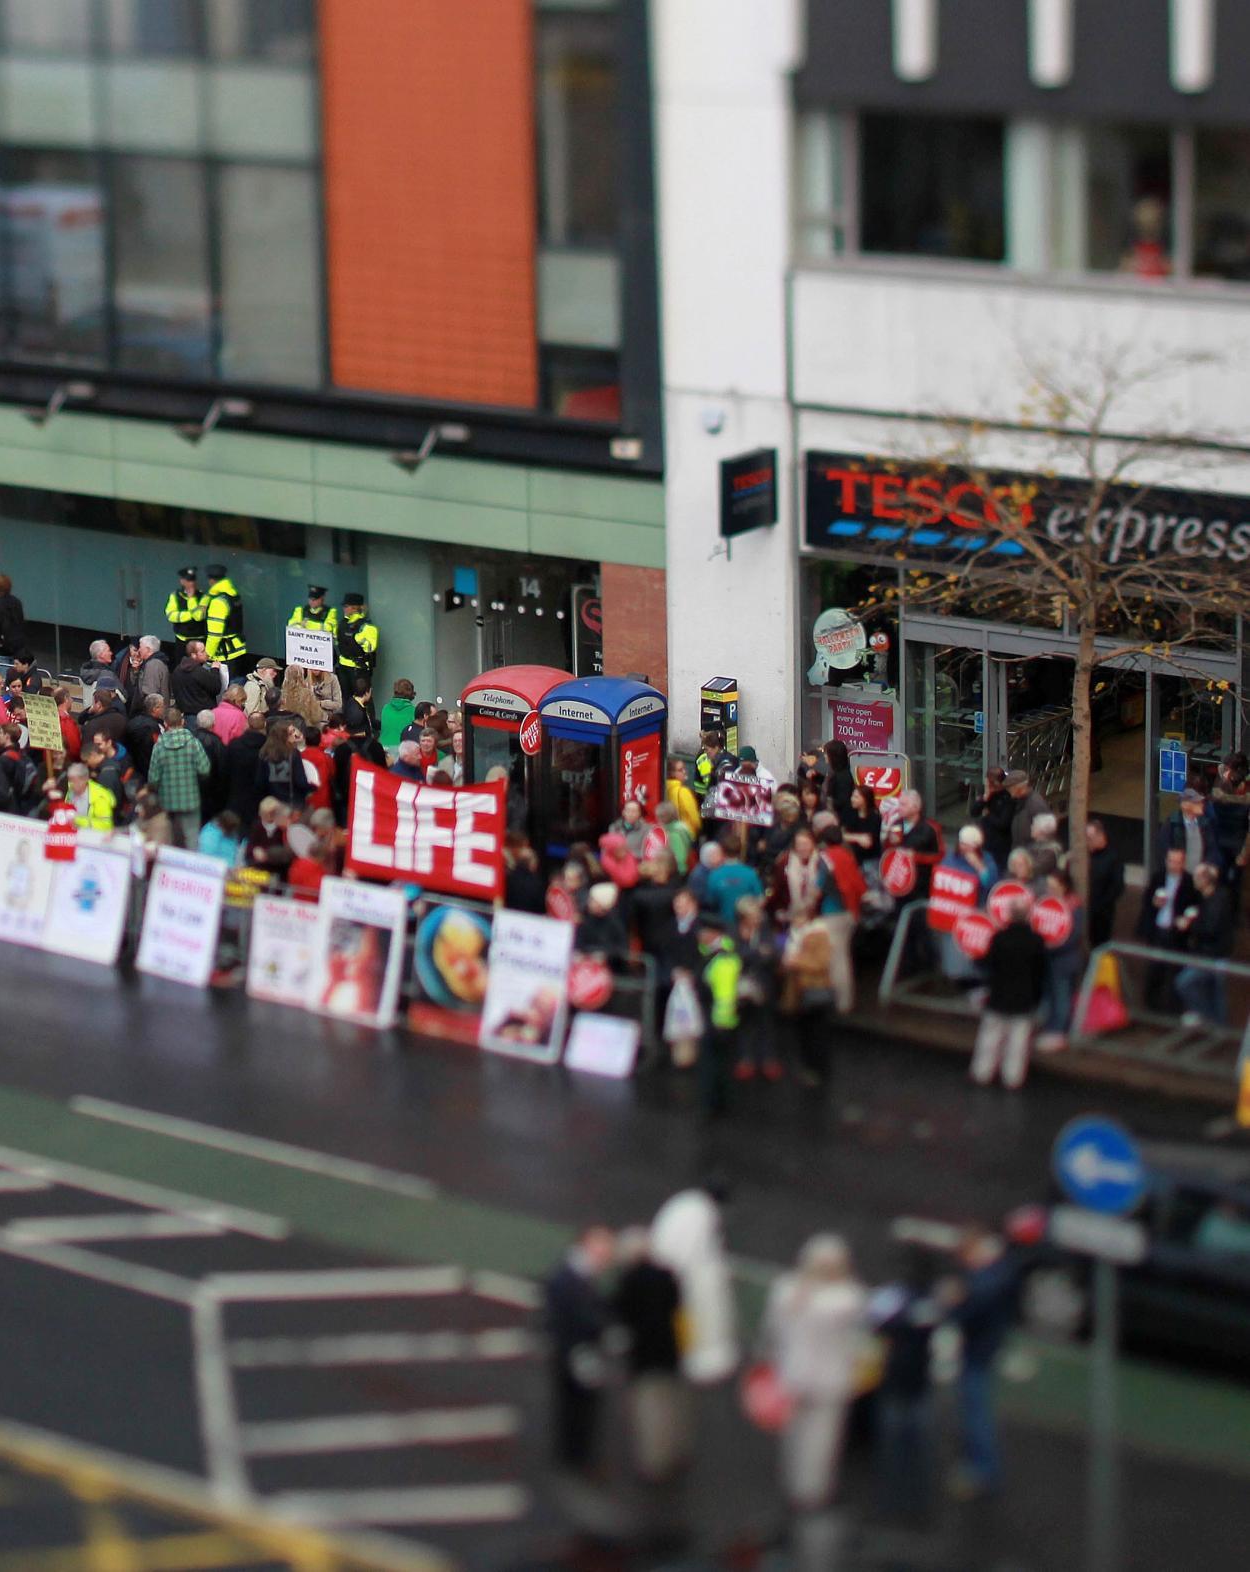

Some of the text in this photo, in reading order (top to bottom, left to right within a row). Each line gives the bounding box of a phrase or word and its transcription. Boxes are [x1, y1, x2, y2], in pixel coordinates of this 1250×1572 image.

[826, 468, 1250, 563] TESCO express
[519, 576, 541, 598] 14
[288, 630, 330, 641] SAINT PATRICK
[293, 656, 325, 666] PRO-LIFER!
[482, 692, 515, 706] Telephone
[479, 707, 494, 716] Coins
[501, 711, 518, 720] Cards
[559, 705, 594, 720] Internet
[629, 701, 653, 718] Internet
[729, 703, 736, 719] P
[836, 705, 872, 718] We're open
[836, 715, 884, 727] every day from
[864, 766, 894, 789] £2
[352, 769, 498, 888] LIFE
